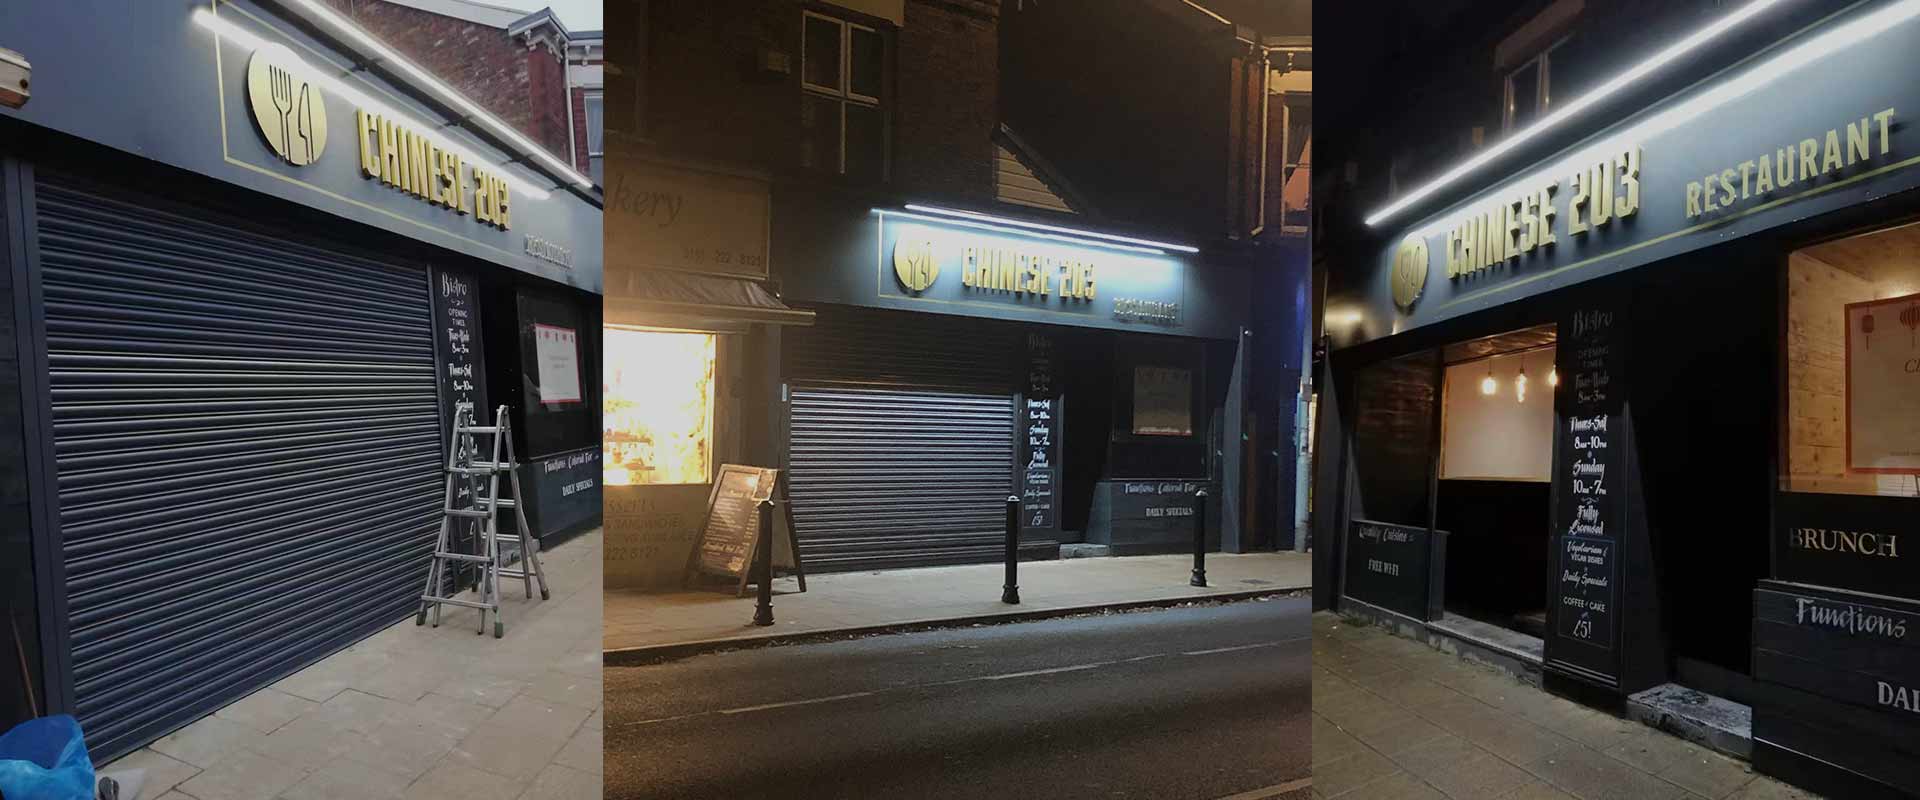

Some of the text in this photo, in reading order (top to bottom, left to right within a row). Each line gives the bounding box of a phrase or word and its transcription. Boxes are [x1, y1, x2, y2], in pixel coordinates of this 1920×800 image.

[357, 107, 511, 231] CHINESE 203
[1447, 108, 1896, 280] CHINESE 203 RESTAURANT
[442, 272, 468, 297] Bistro
[962, 246, 1096, 300] CHINESE 203
[1572, 458, 1606, 480] Sunday
[1577, 505, 1599, 525] Fully
[1789, 527, 1899, 558] BRUNCH
[1563, 596, 1585, 608] COFFEE
[1589, 601, 1606, 613] CAKE
[1795, 597, 1908, 640] Functions
